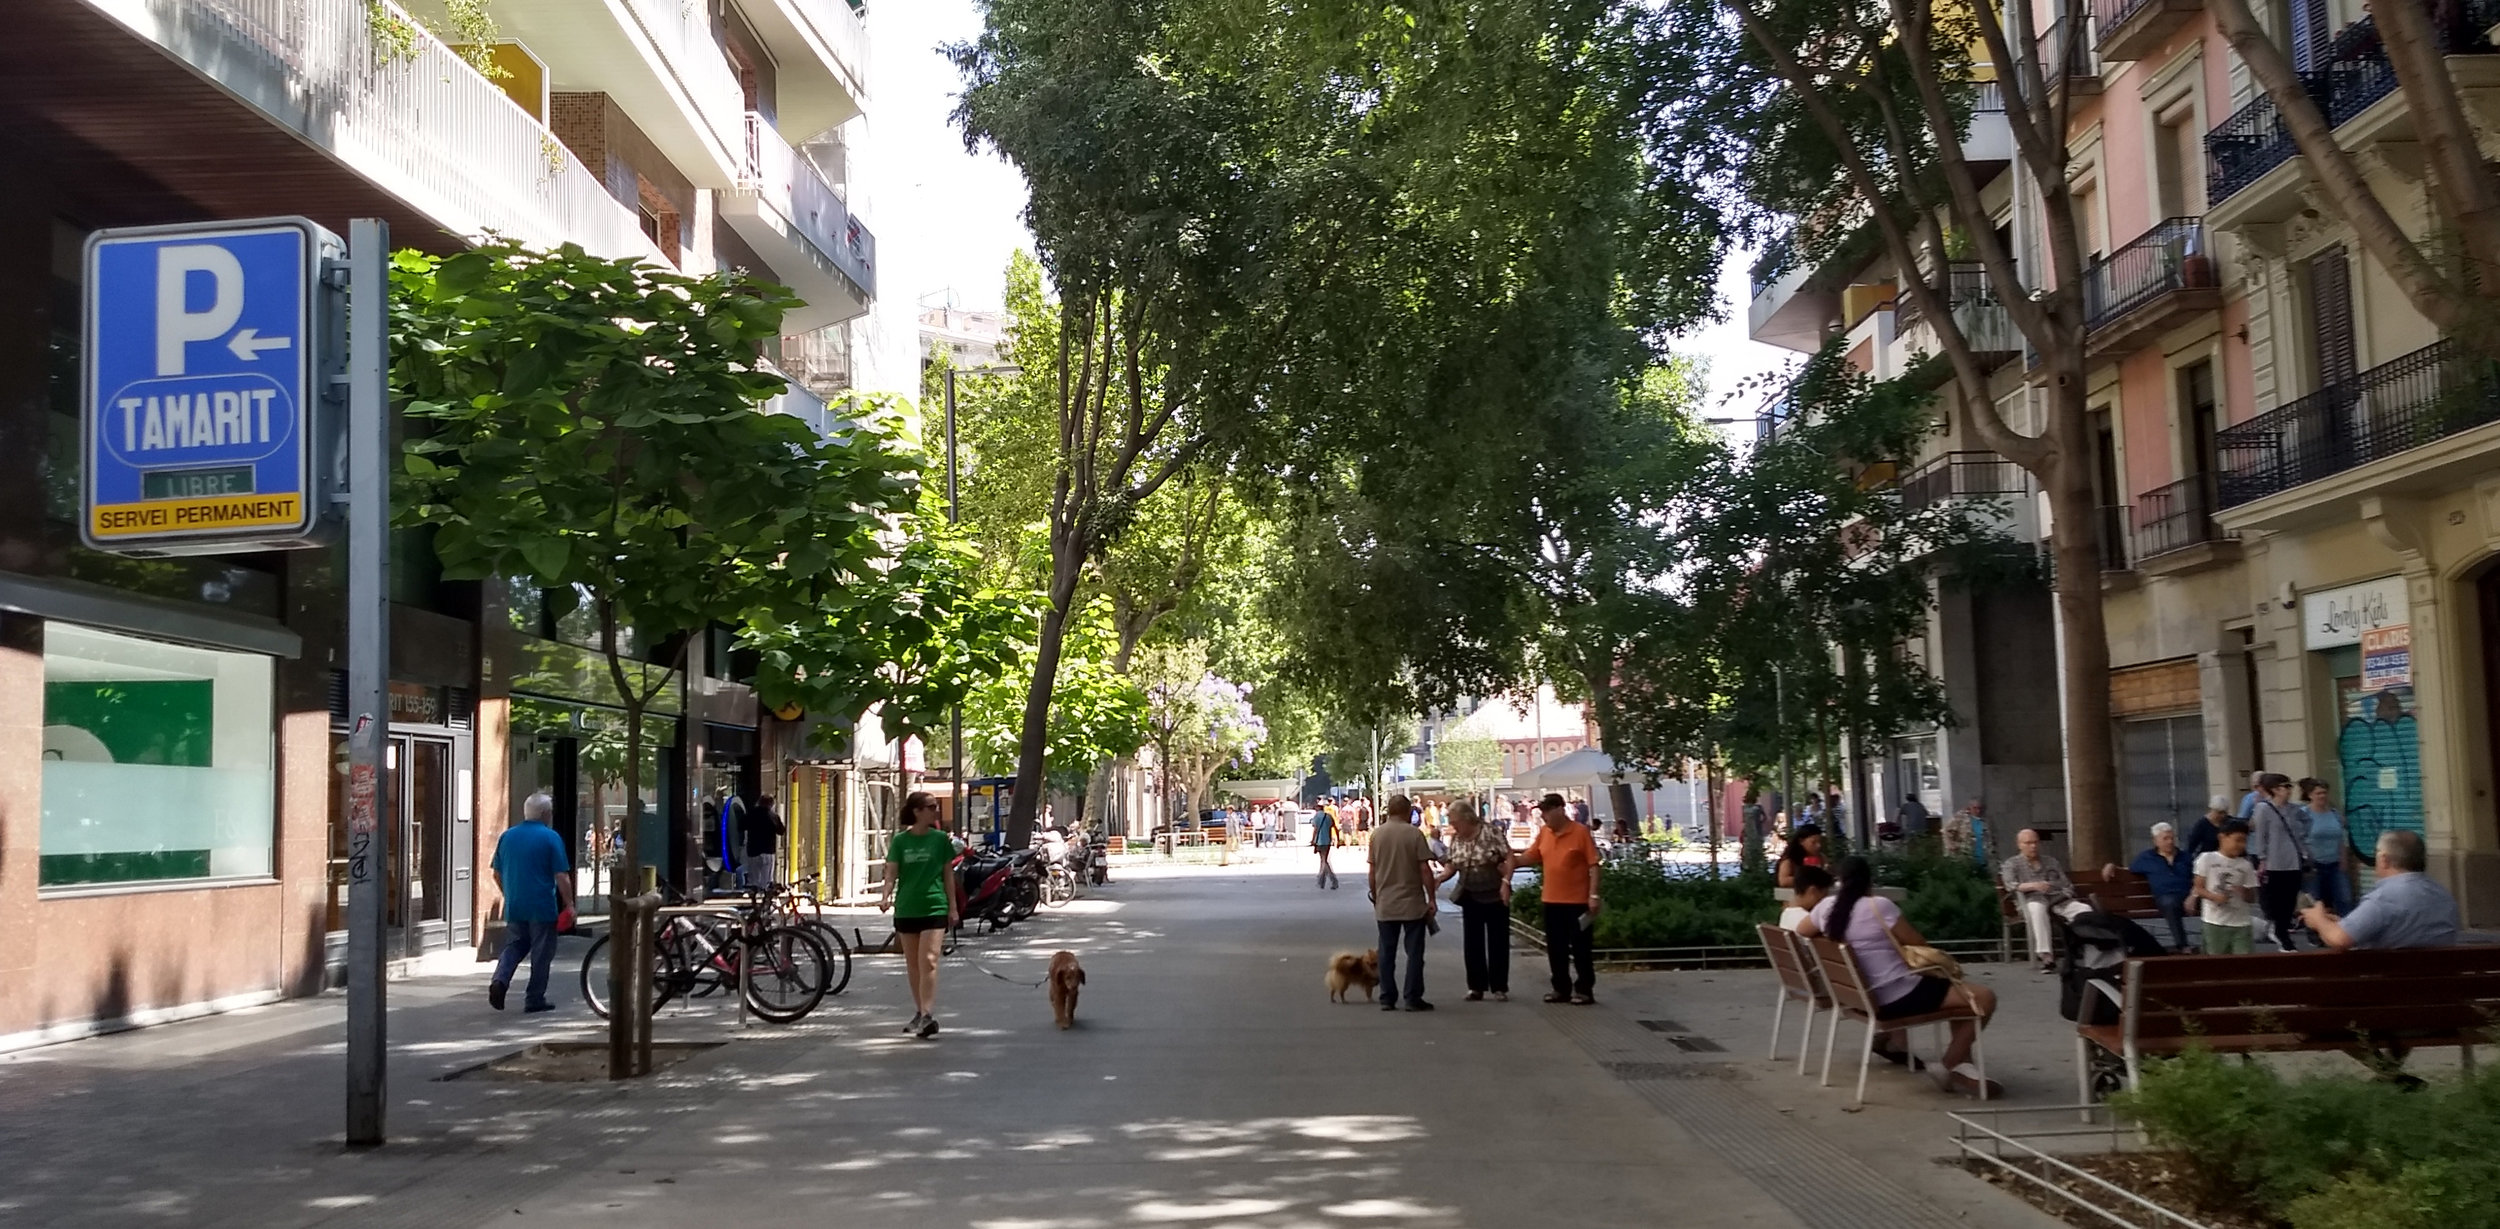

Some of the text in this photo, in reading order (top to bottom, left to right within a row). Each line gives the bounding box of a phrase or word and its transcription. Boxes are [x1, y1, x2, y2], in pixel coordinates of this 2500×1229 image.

[157, 244, 245, 377] P
[118, 388, 277, 452] TAMARIT
[165, 474, 238, 498] LIBRE
[100, 500, 294, 529] SERVEI PERMANENT
[2320, 589, 2389, 639] Lovely Kids
